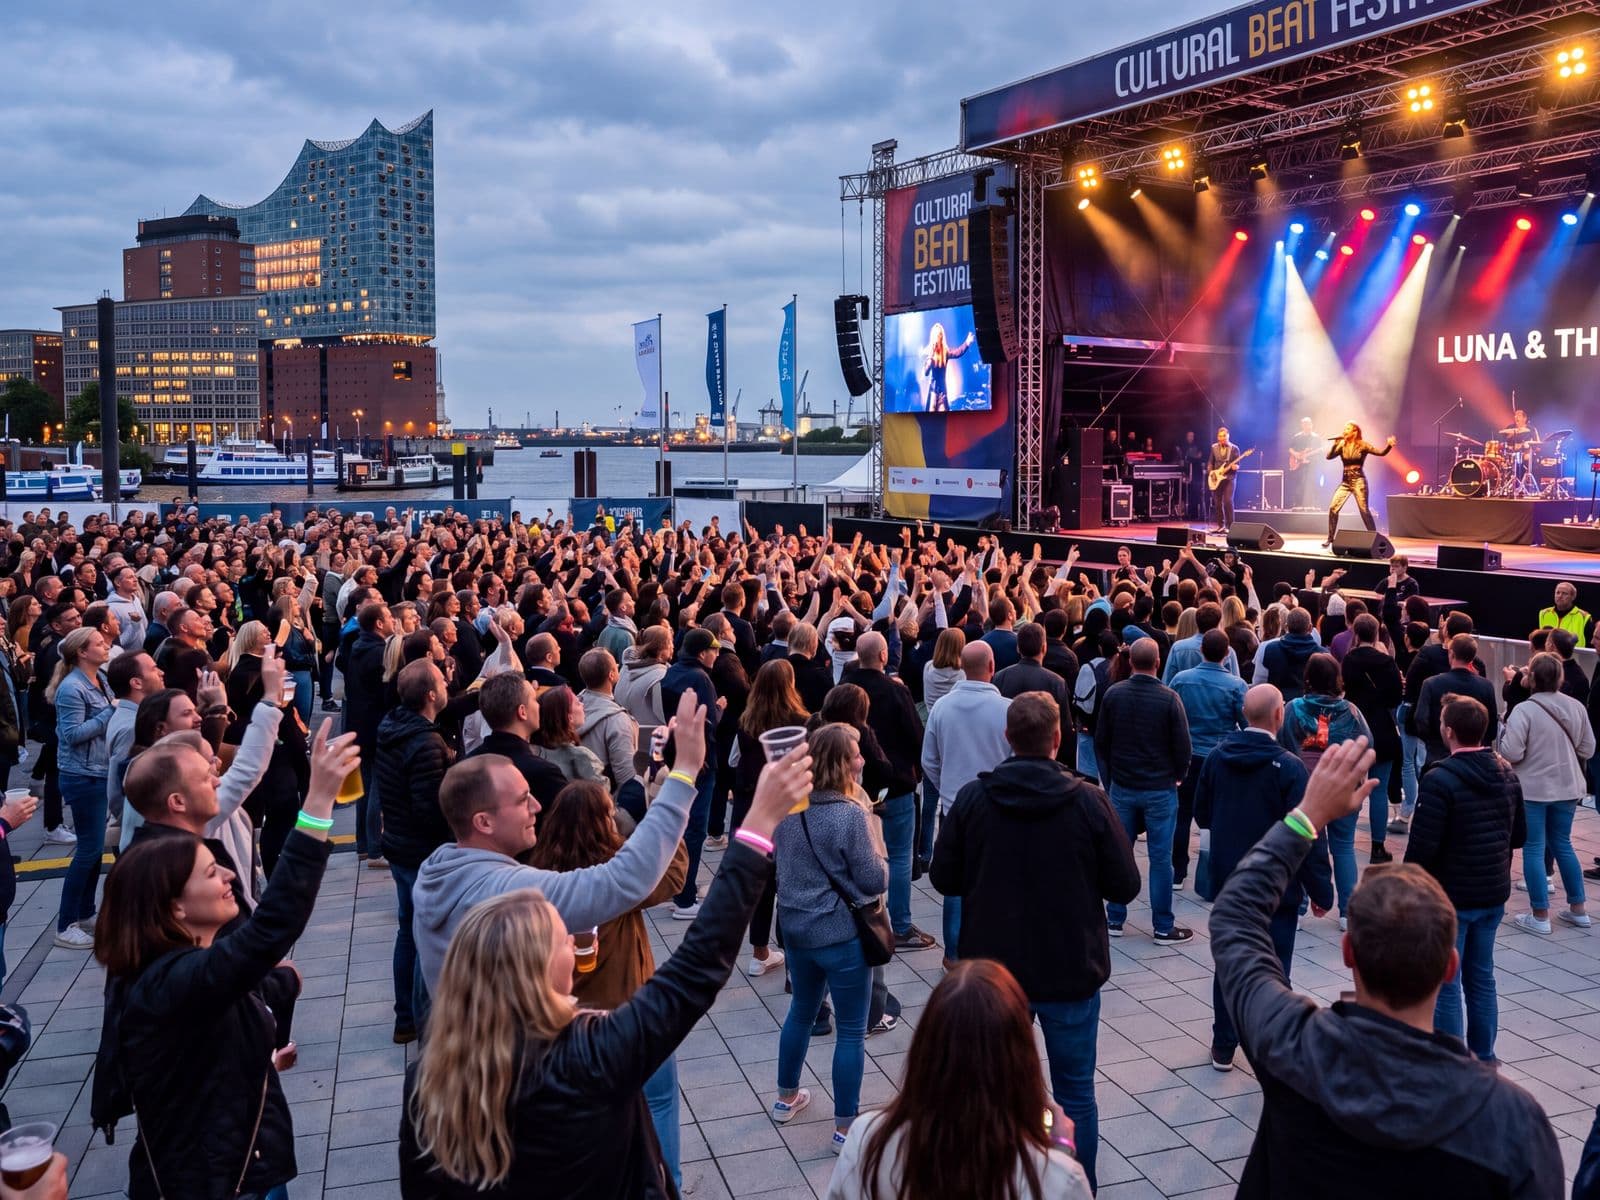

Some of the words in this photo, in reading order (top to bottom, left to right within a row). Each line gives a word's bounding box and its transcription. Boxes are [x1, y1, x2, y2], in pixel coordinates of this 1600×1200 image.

[1115, 22, 1240, 98] CULTURAL
[1248, 0, 1317, 58] BEAT
[914, 218, 969, 270] BEAT
[1437, 332, 1518, 364] LUNA
[1524, 330, 1547, 359] &
[1554, 326, 1598, 358] TH
